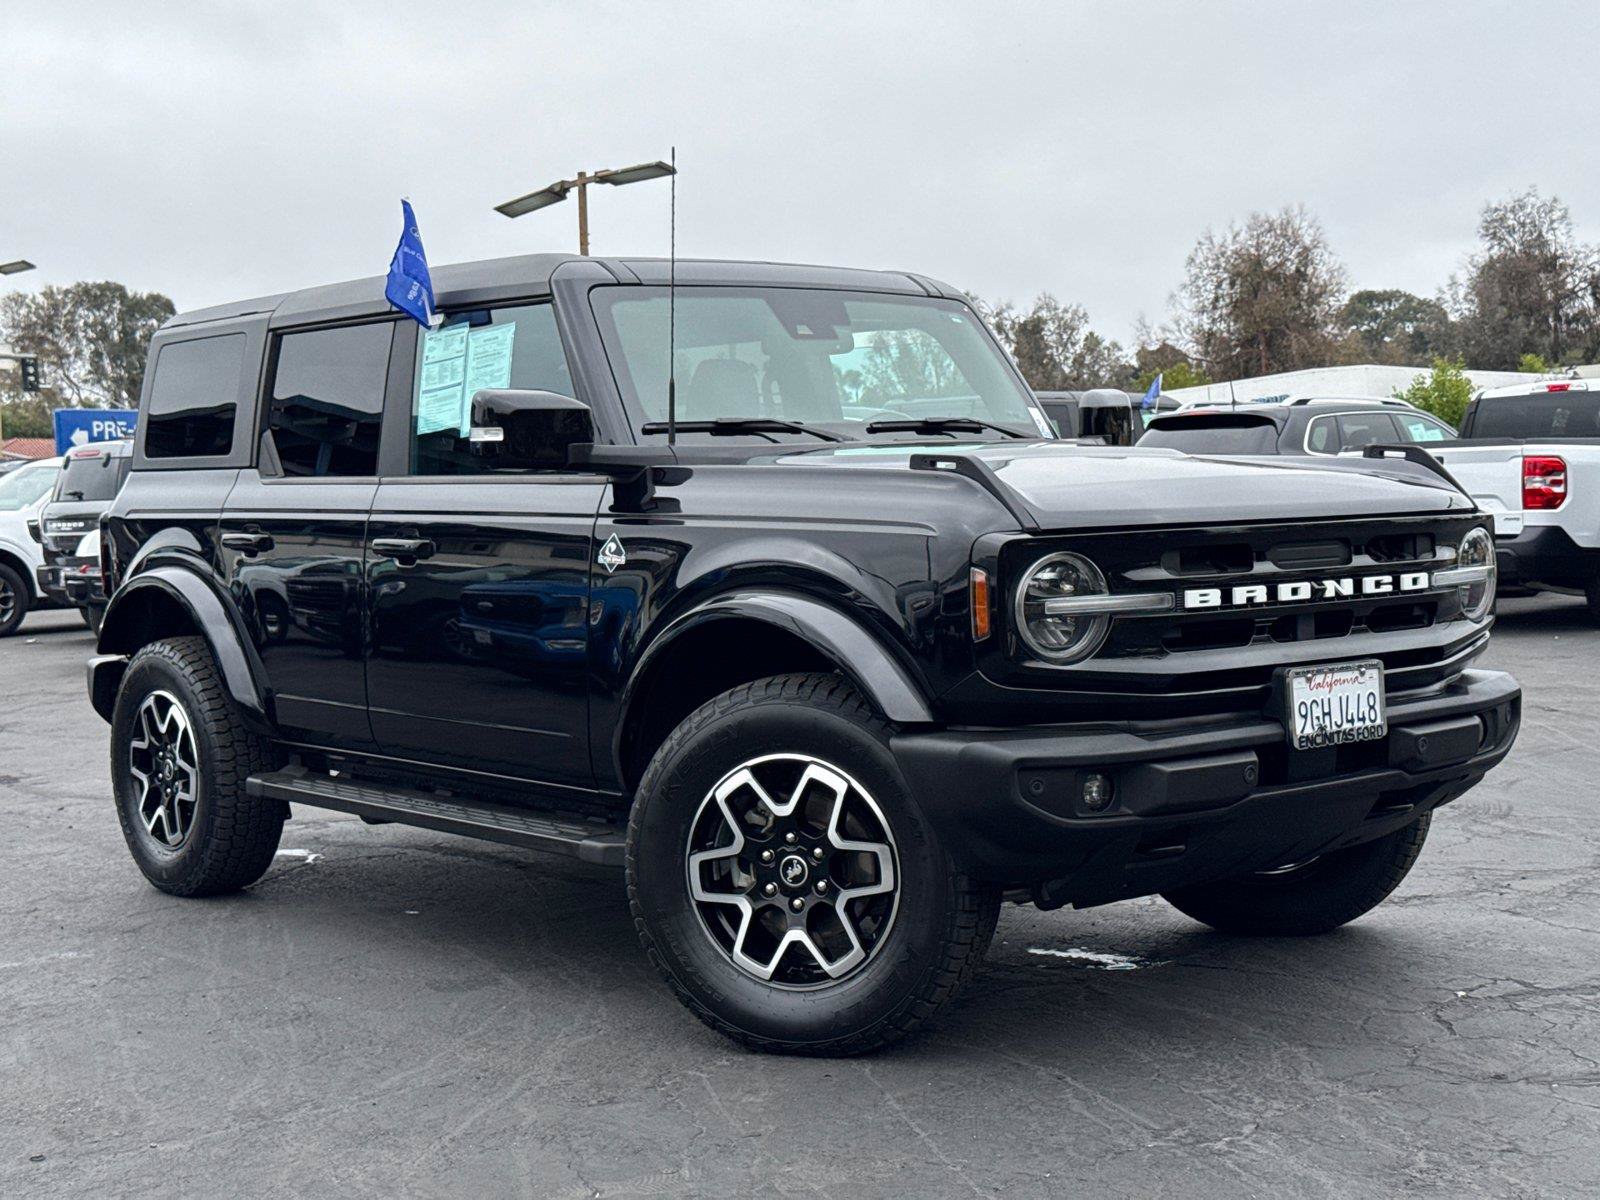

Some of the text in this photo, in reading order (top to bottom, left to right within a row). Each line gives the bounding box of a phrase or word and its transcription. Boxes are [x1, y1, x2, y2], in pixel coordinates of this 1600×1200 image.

[92, 420, 137, 440] PRE-
[1184, 572, 1429, 609] BRONCO
[1308, 671, 1365, 694] California
[1298, 691, 1378, 734] 9GHJ448
[1298, 725, 1384, 749] ENCINITAS FORD
